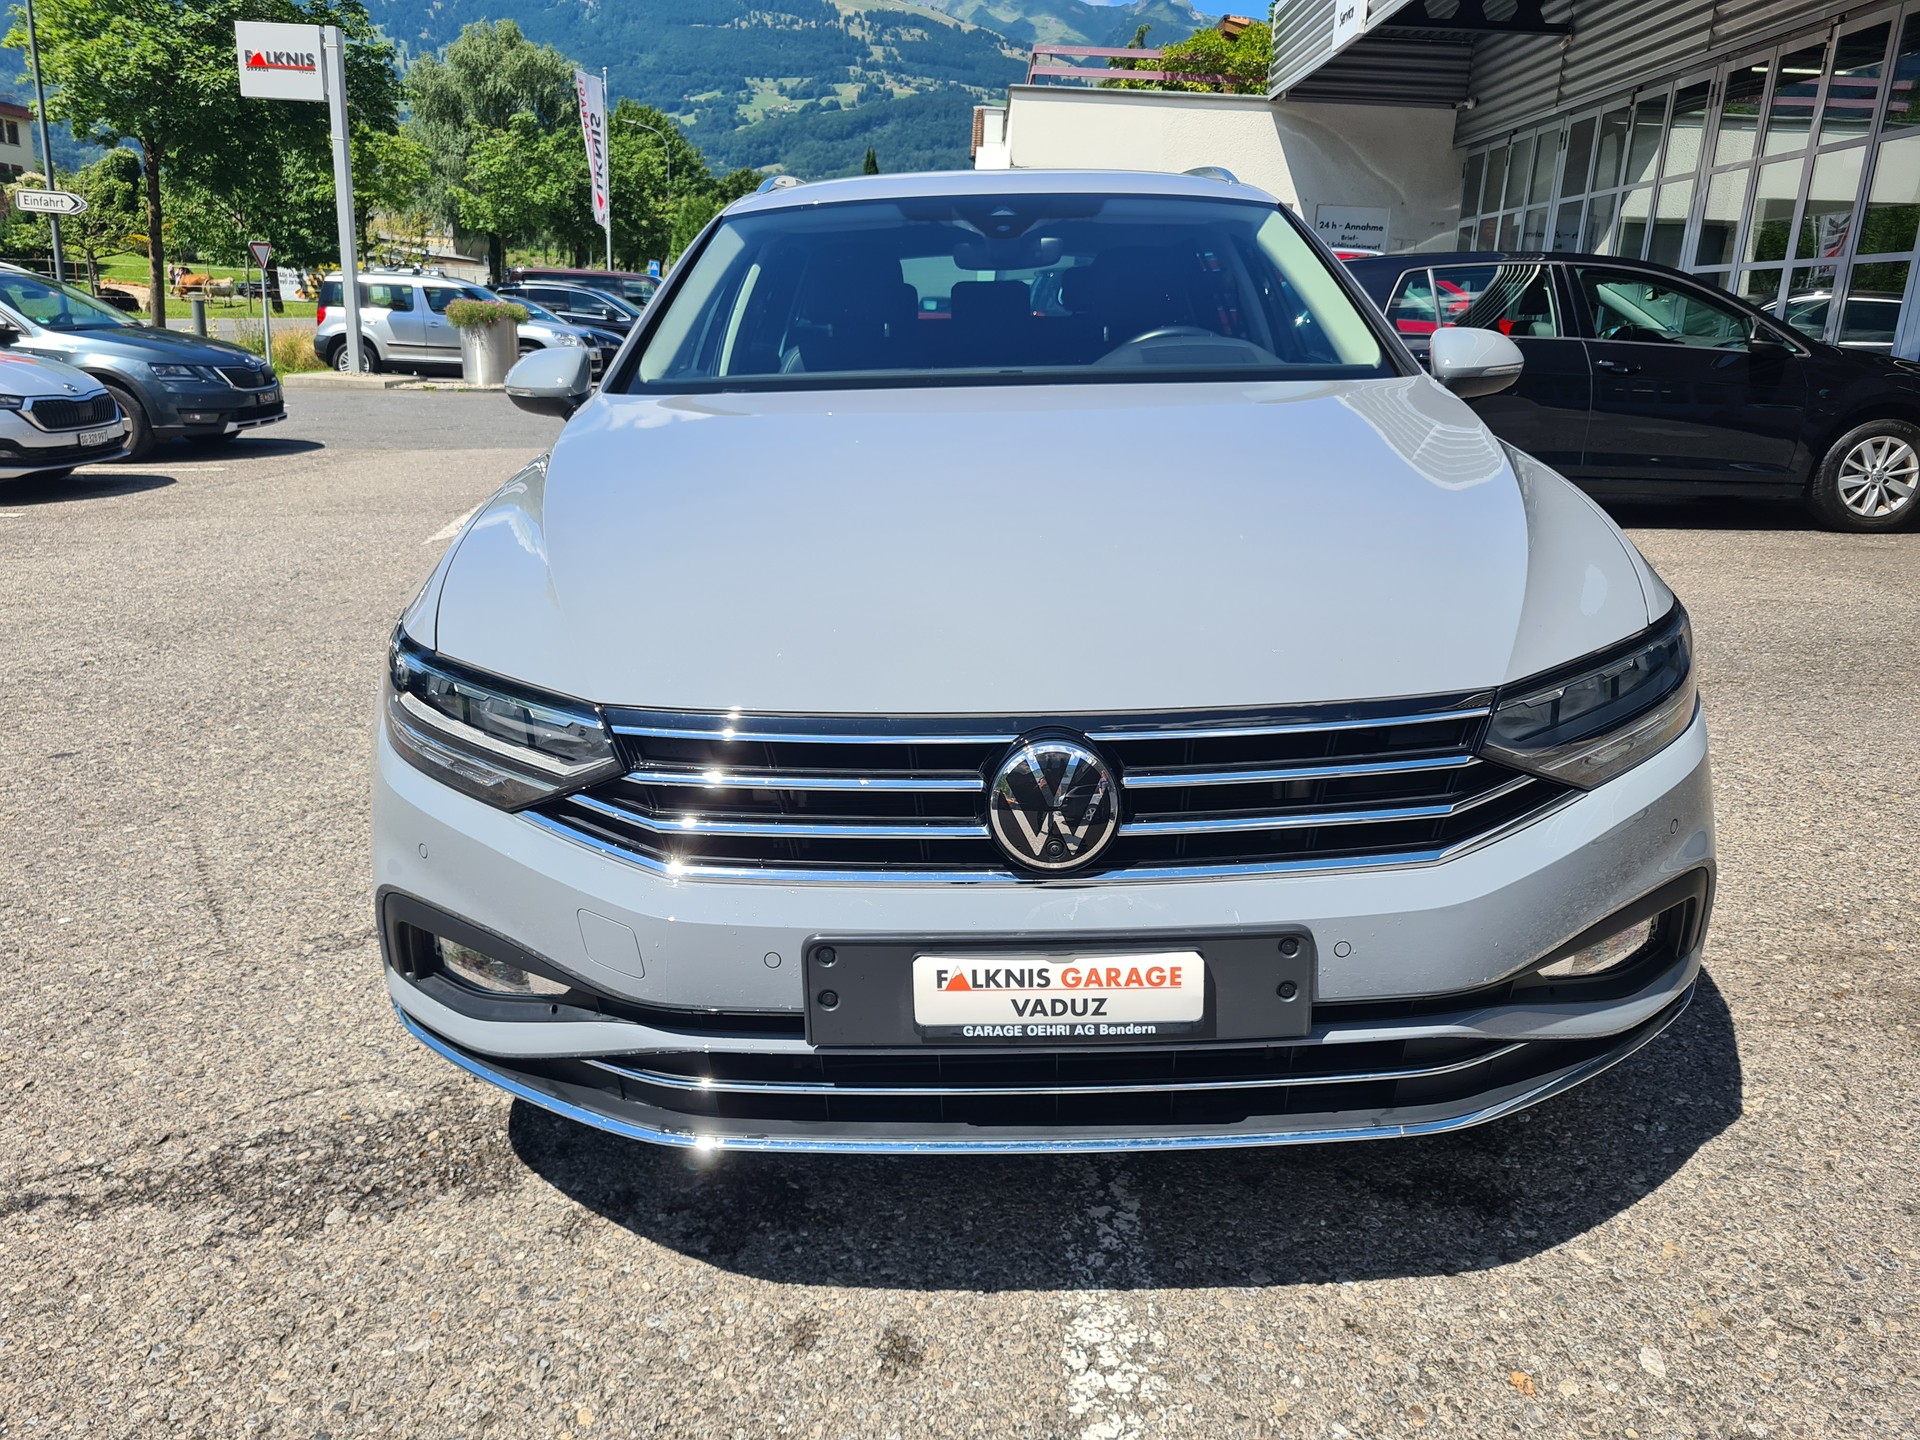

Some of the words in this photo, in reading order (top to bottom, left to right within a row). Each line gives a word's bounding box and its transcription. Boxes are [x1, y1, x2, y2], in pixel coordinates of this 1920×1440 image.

[244, 49, 316, 66] FALKNIS
[23, 195, 65, 208] Einfahrt
[1319, 221, 1329, 229] 24
[1331, 221, 1337, 229] h
[1344, 222, 1384, 231] Annahme
[936, 966, 1051, 989] FALKNIS
[1060, 966, 1182, 988] GARAGE
[1010, 998, 1108, 1017] VADUZ
[963, 1026, 1023, 1037] GARAGE
[1027, 1025, 1070, 1036] OEHRI
[1074, 1024, 1095, 1036] AG
[1099, 1023, 1156, 1036] Bendern
